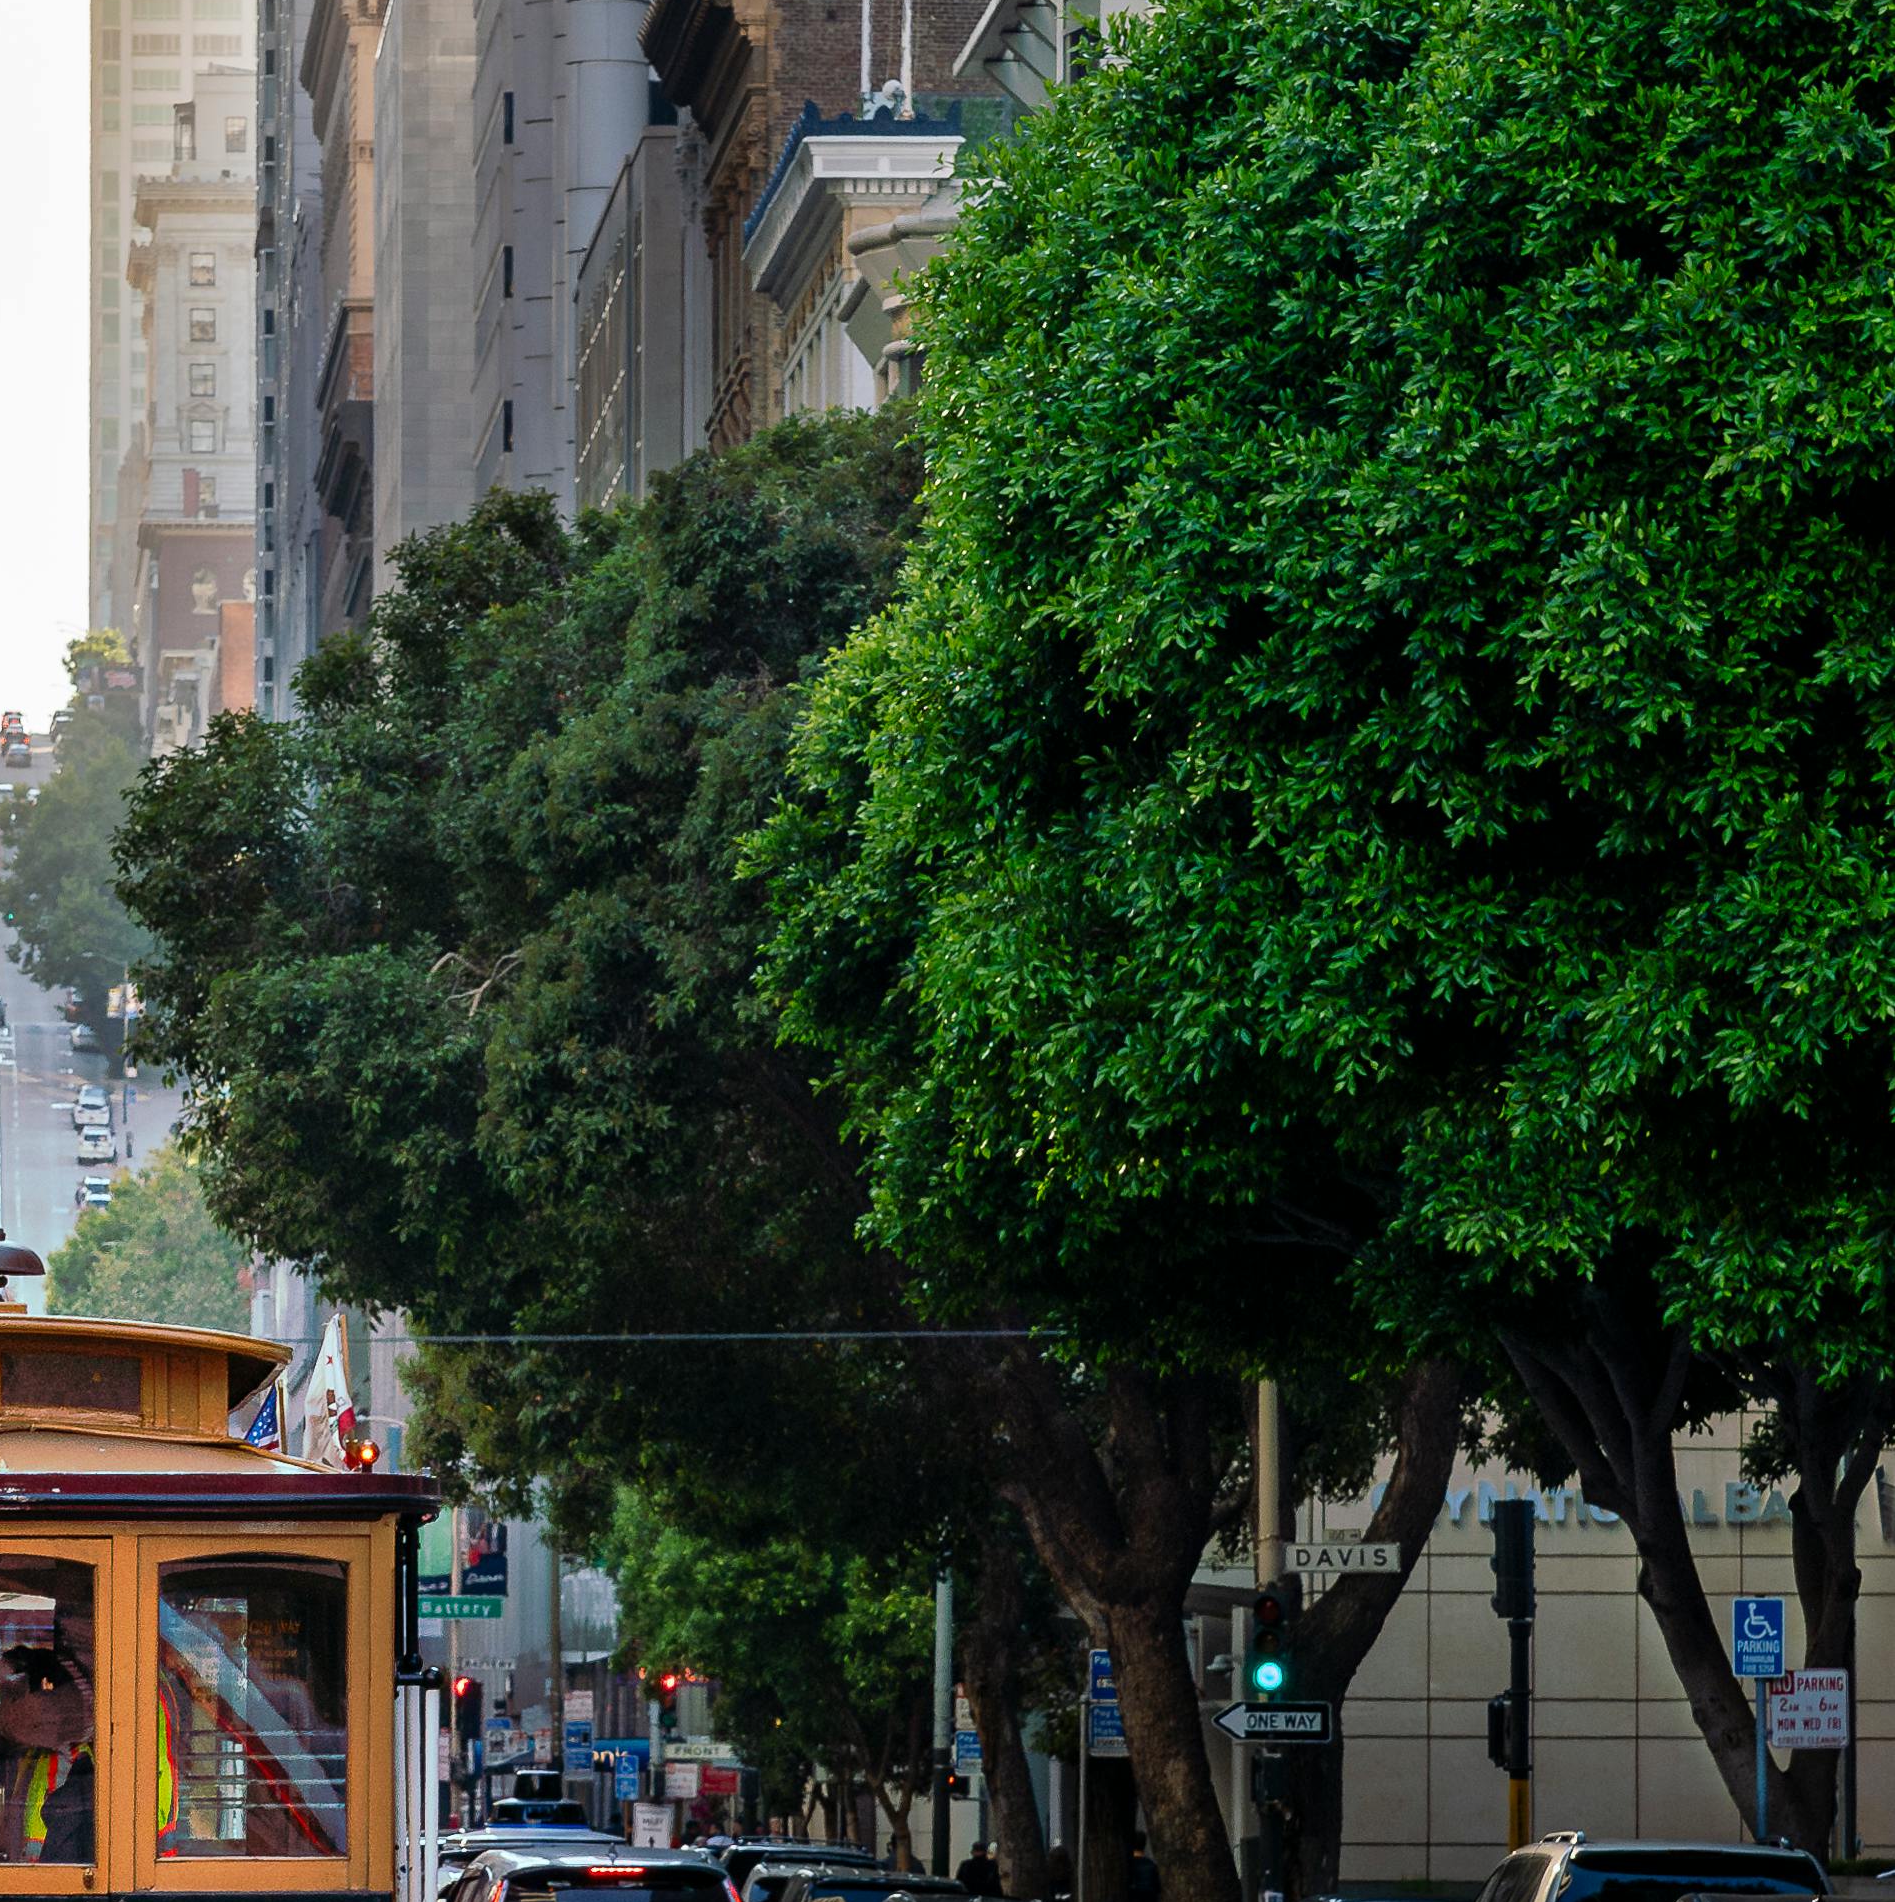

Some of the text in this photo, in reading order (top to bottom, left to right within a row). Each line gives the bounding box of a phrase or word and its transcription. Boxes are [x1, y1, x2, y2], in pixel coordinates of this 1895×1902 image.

[1295, 1549, 1388, 1567] DAVIS
[421, 1601, 492, 1616] Battery
[1737, 1640, 1780, 1653] PARKING
[1797, 1677, 1844, 1692] PARKING
[1247, 1713, 1316, 1729] ONE WAY
[1778, 1718, 1796, 1731] MON
[1827, 1717, 1842, 1730] FRI
